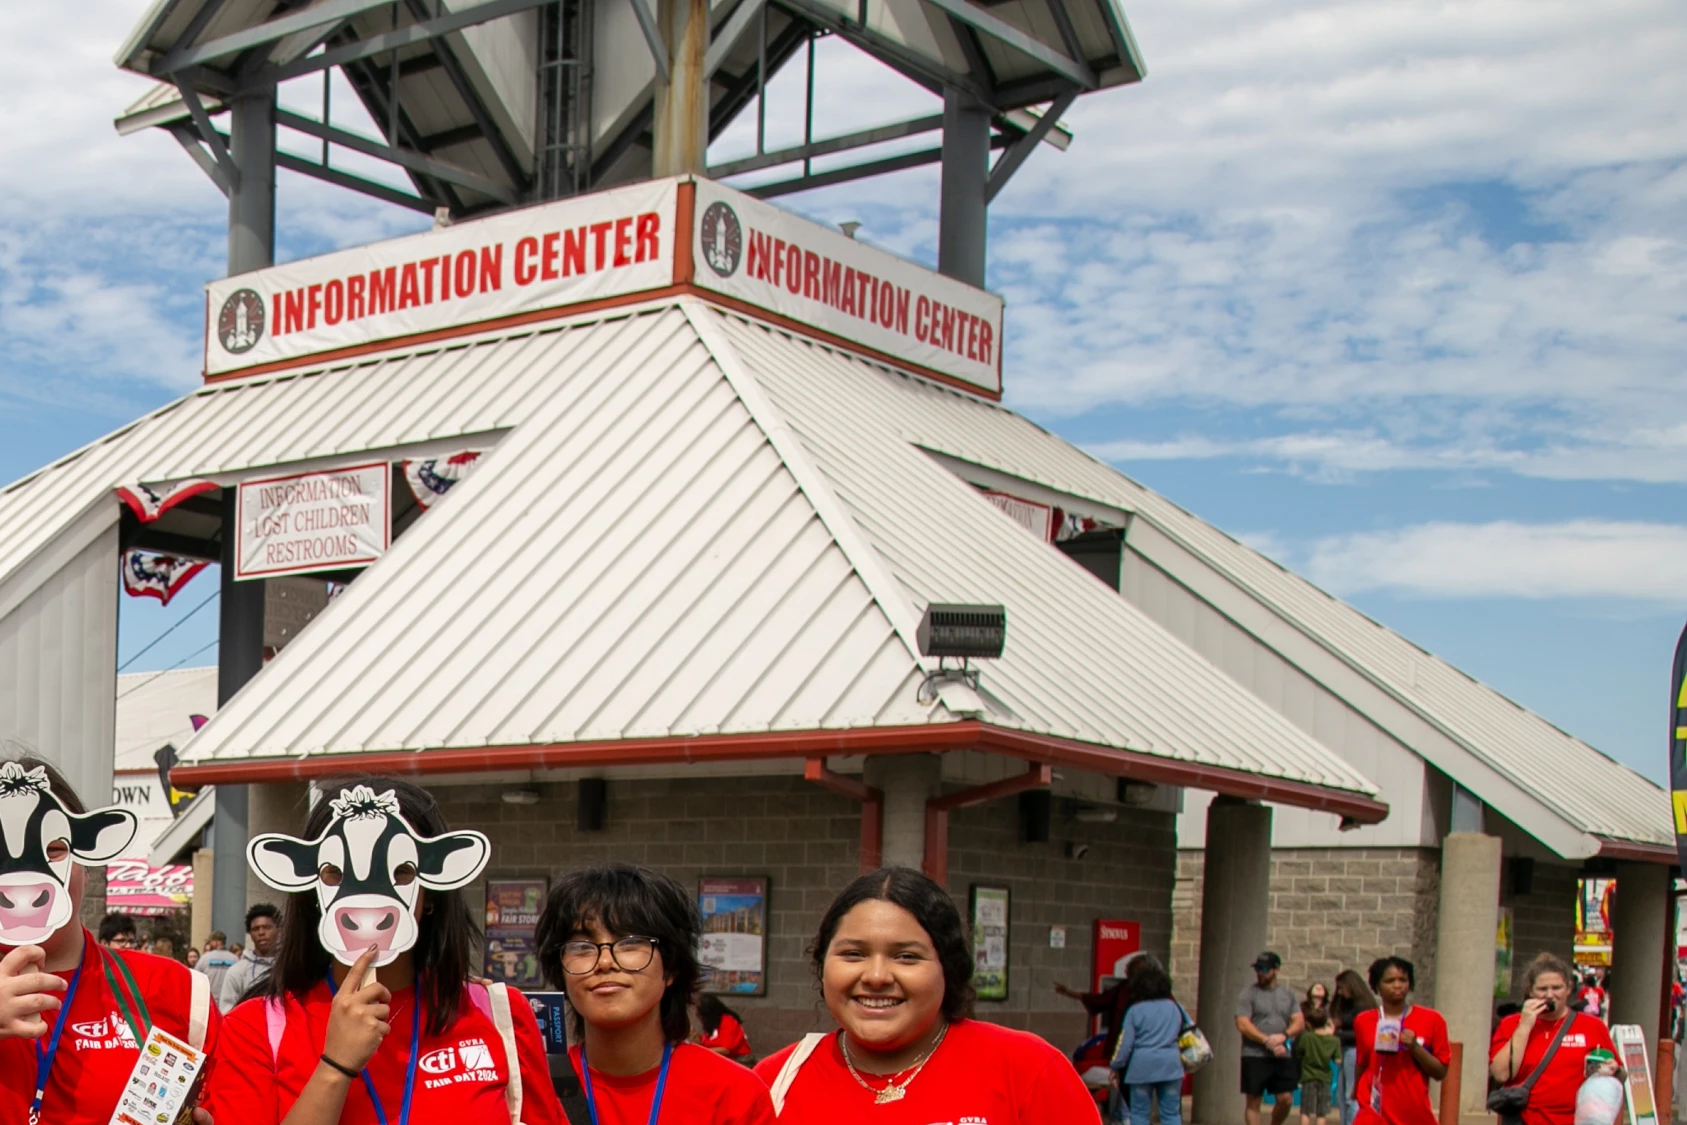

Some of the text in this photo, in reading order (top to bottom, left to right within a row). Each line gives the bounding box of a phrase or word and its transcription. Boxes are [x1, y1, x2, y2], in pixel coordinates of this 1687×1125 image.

[271, 211, 661, 337] INFORMATION CENTER
[746, 227, 993, 366] INFORMATION CENTER
[261, 475, 362, 509] INFORMATION
[254, 503, 370, 538] LOST CHILDREN
[266, 535, 358, 565] RESTROOMS
[107, 861, 194, 889] Taff
[76, 1017, 108, 1036] cti
[553, 1006, 563, 1043] PASSPORT
[75, 1038, 102, 1052] FAIR
[459, 1038, 485, 1047] GVRA
[422, 1047, 456, 1072] cti
[424, 1069, 499, 1089] FAIR DAY 2024
[959, 1116, 988, 1125] GVRA
